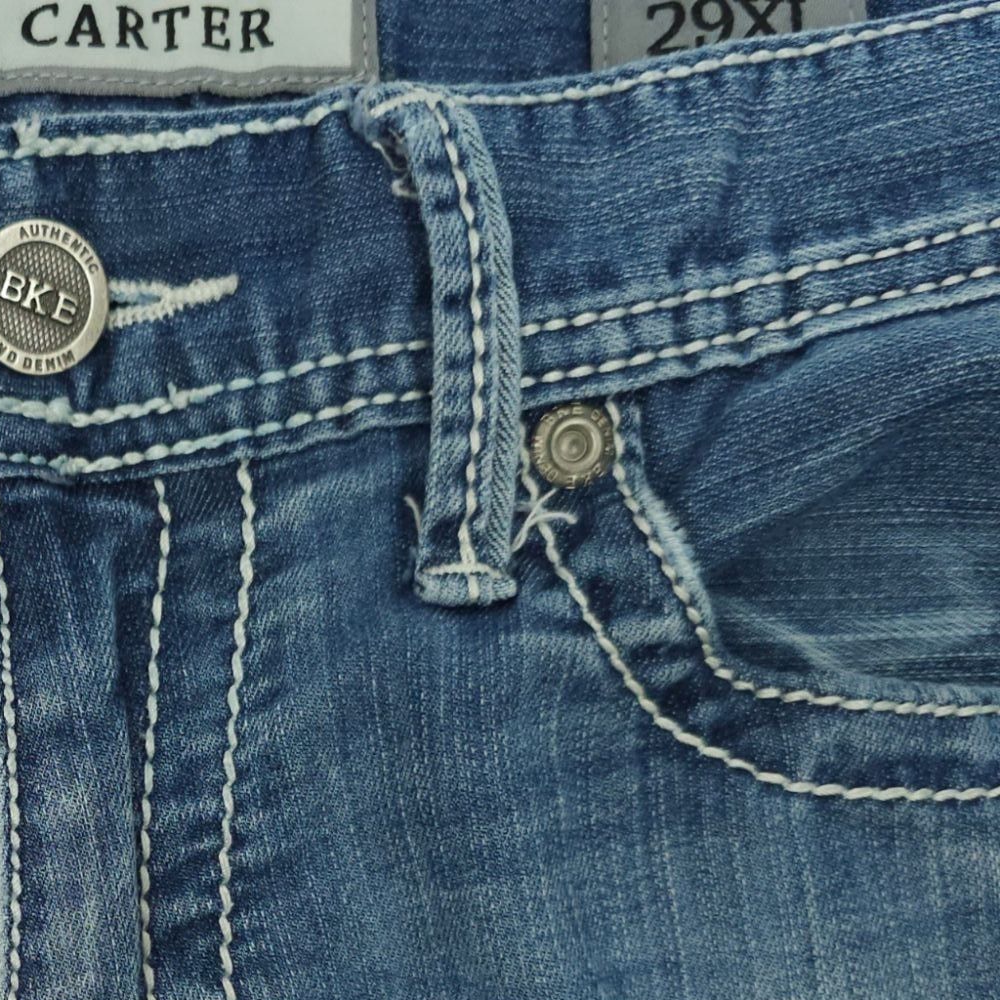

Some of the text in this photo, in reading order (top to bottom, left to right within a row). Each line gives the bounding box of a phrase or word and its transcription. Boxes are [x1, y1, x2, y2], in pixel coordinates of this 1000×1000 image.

[21, 2, 275, 53] CARTER
[19, 224, 99, 275] AUTHENTIC
[0, 269, 79, 325] BKE
[23, 350, 76, 373] DENIM
